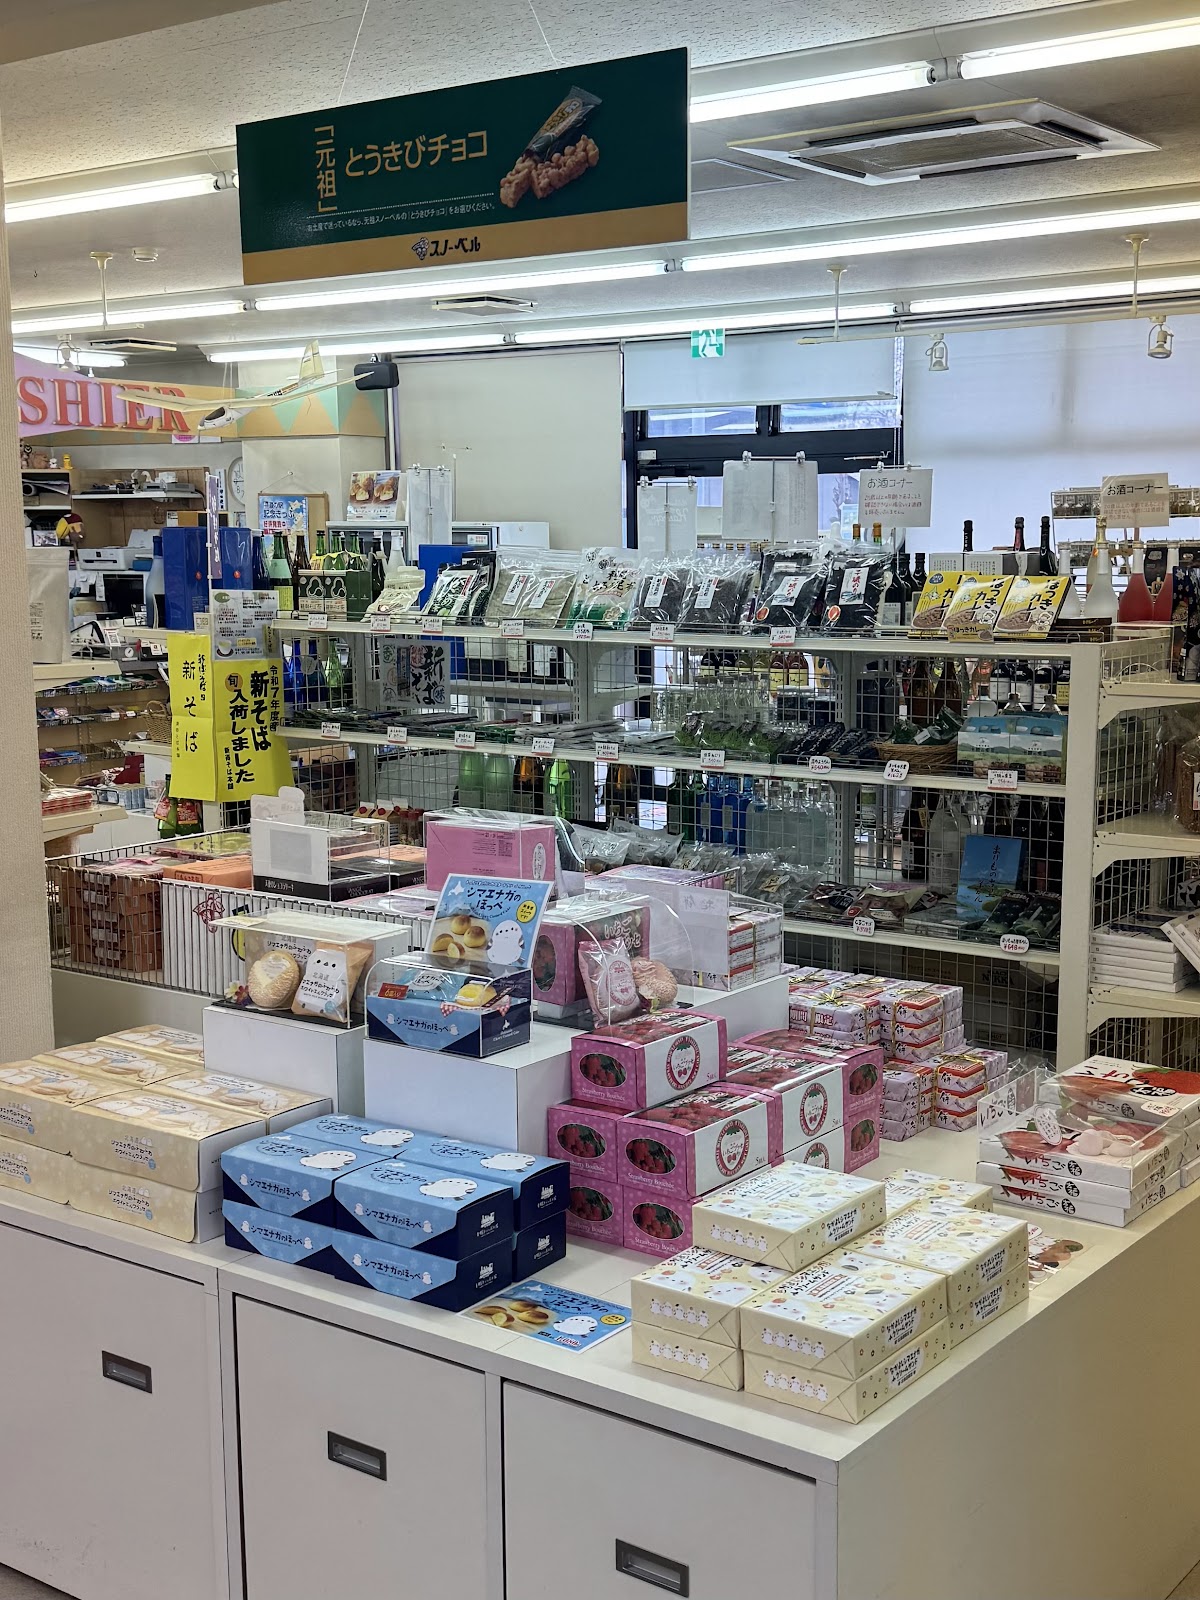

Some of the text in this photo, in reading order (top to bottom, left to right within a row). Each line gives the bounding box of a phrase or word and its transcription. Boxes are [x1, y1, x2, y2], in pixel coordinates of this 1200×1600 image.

[345, 130, 488, 177] とうきびチョコ
[429, 236, 481, 257] スノーベル
[1107, 483, 1164, 495] お酒コーナー
[1027, 592, 1041, 623] カレー
[182, 660, 198, 753] 新そば
[250, 670, 272, 752] 新そば
[229, 688, 255, 784] 入荷しました
[467, 887, 522, 902] シマエナガの
[476, 899, 503, 911] ほっぺ
[396, 1016, 449, 1032] シマエナガのほっぺ
[248, 1177, 303, 1199] シマエナガのほっぺ
[628, 1172, 653, 1184] Strawberry
[365, 1206, 422, 1229] シマエナガのほっぺ
[250, 1225, 305, 1247] シマエナガのほっぺ
[634, 1236, 661, 1248] Strawberry
[363, 1258, 422, 1281] シマエナガのほっぺ
[543, 1290, 610, 1313] シマエナガの
